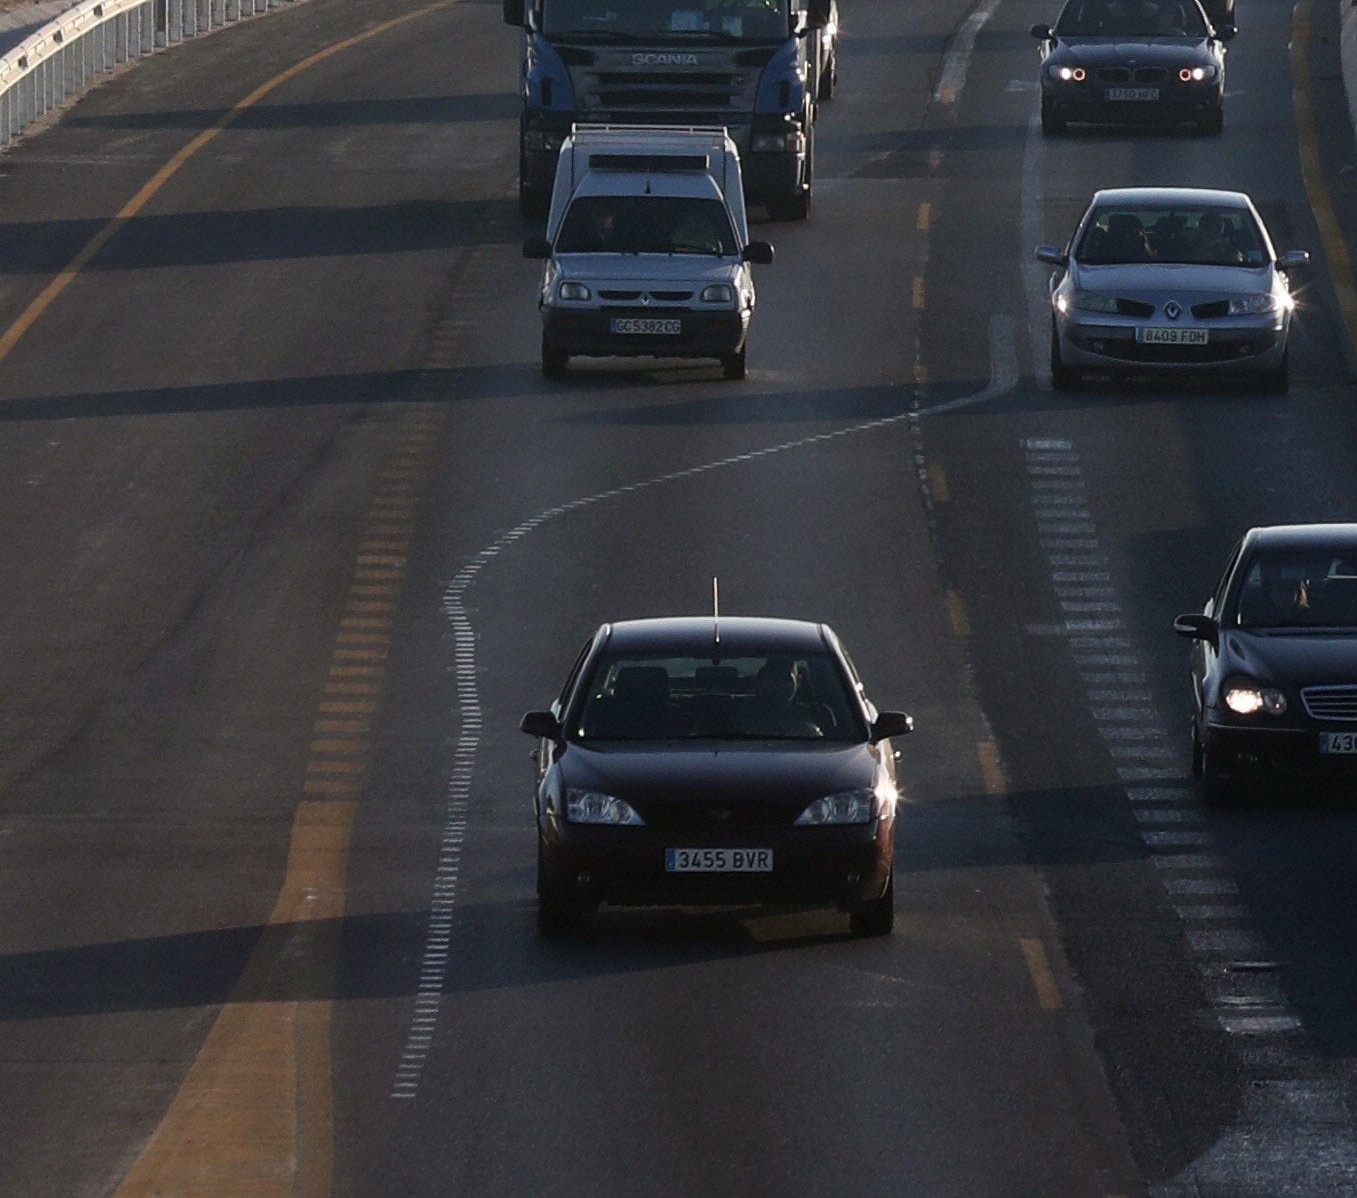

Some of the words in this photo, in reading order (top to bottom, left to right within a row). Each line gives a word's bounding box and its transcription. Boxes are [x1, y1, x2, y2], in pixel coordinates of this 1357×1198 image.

[631, 53, 699, 65] SCANIA
[1145, 329, 1177, 342] 8409
[678, 850, 727, 869] 3455
[732, 851, 769, 869] BVR
